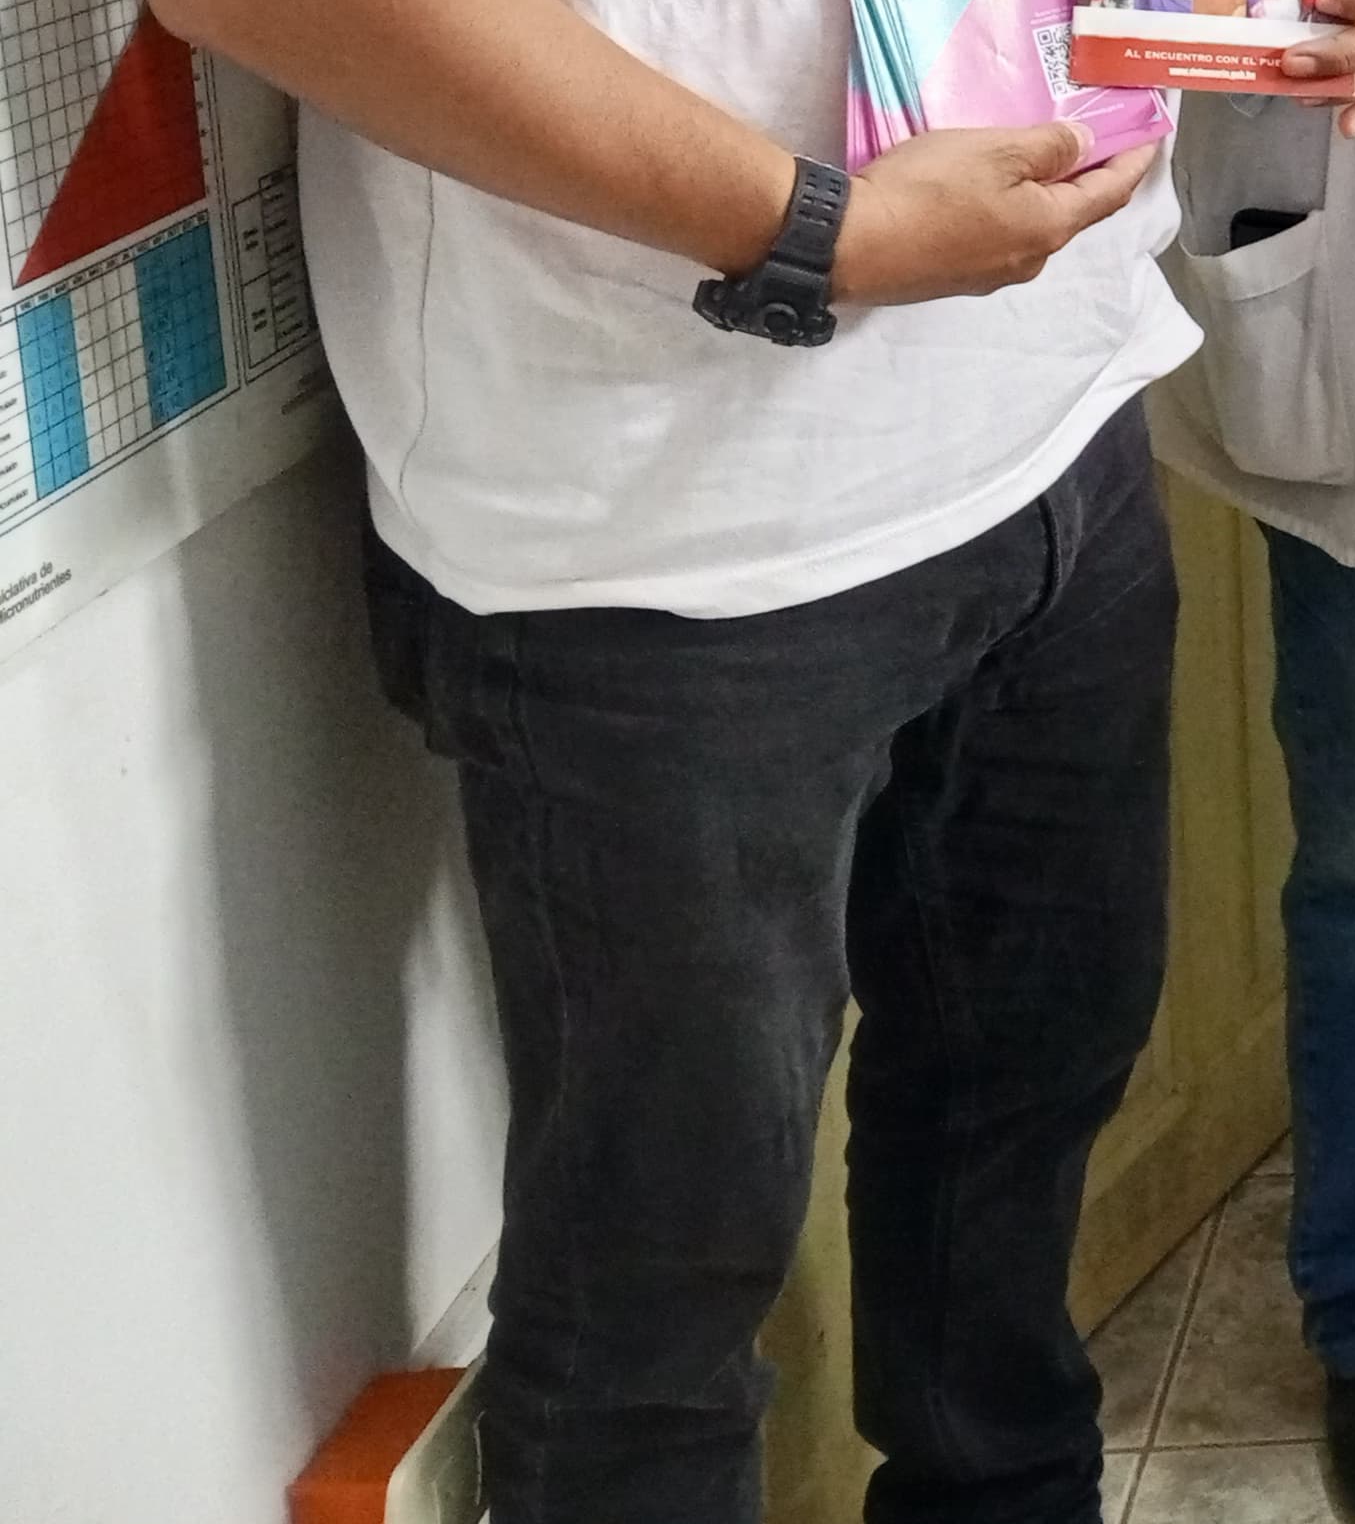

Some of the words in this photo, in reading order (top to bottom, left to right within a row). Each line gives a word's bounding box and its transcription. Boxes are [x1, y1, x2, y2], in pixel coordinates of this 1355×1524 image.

[1124, 48, 1141, 59] AL
[1144, 51, 1214, 63] ENCUENTRO
[1215, 54, 1239, 64] CON
[1242, 56, 1257, 66] EL
[1259, 58, 1282, 68] PUE
